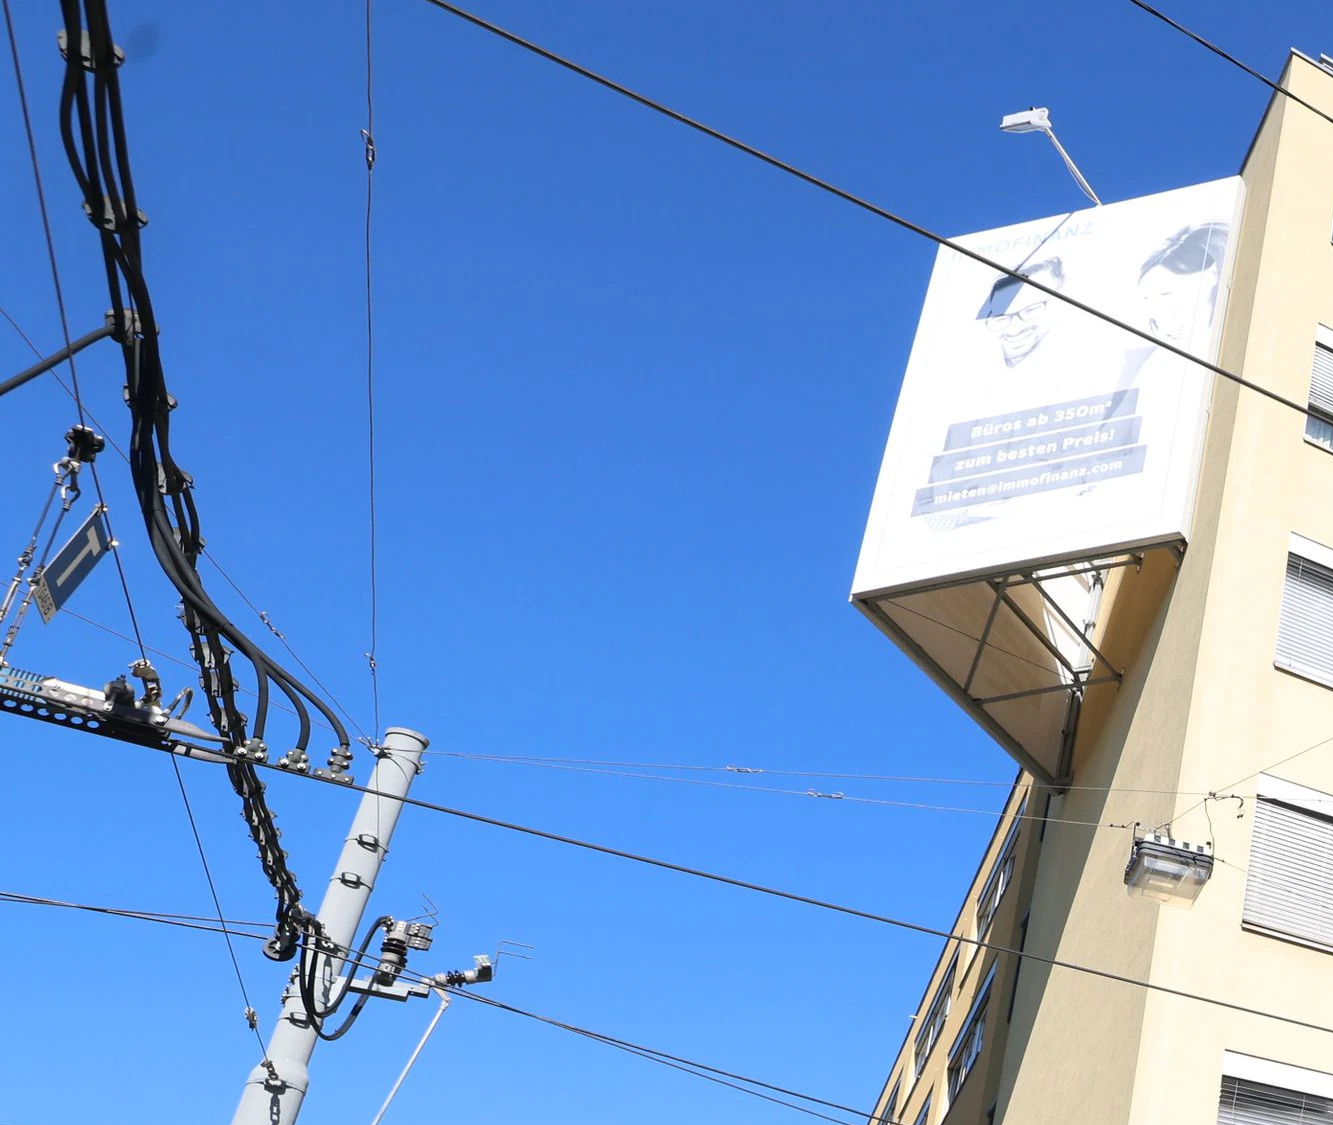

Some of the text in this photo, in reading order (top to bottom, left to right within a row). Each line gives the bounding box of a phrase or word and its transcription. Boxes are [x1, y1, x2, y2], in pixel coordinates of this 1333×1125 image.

[970, 418, 1022, 439] Büros
[1026, 413, 1049, 429] ab
[954, 429, 1115, 471] zum besten Preis!
[934, 459, 1124, 504] mieten@immofinanz.com
